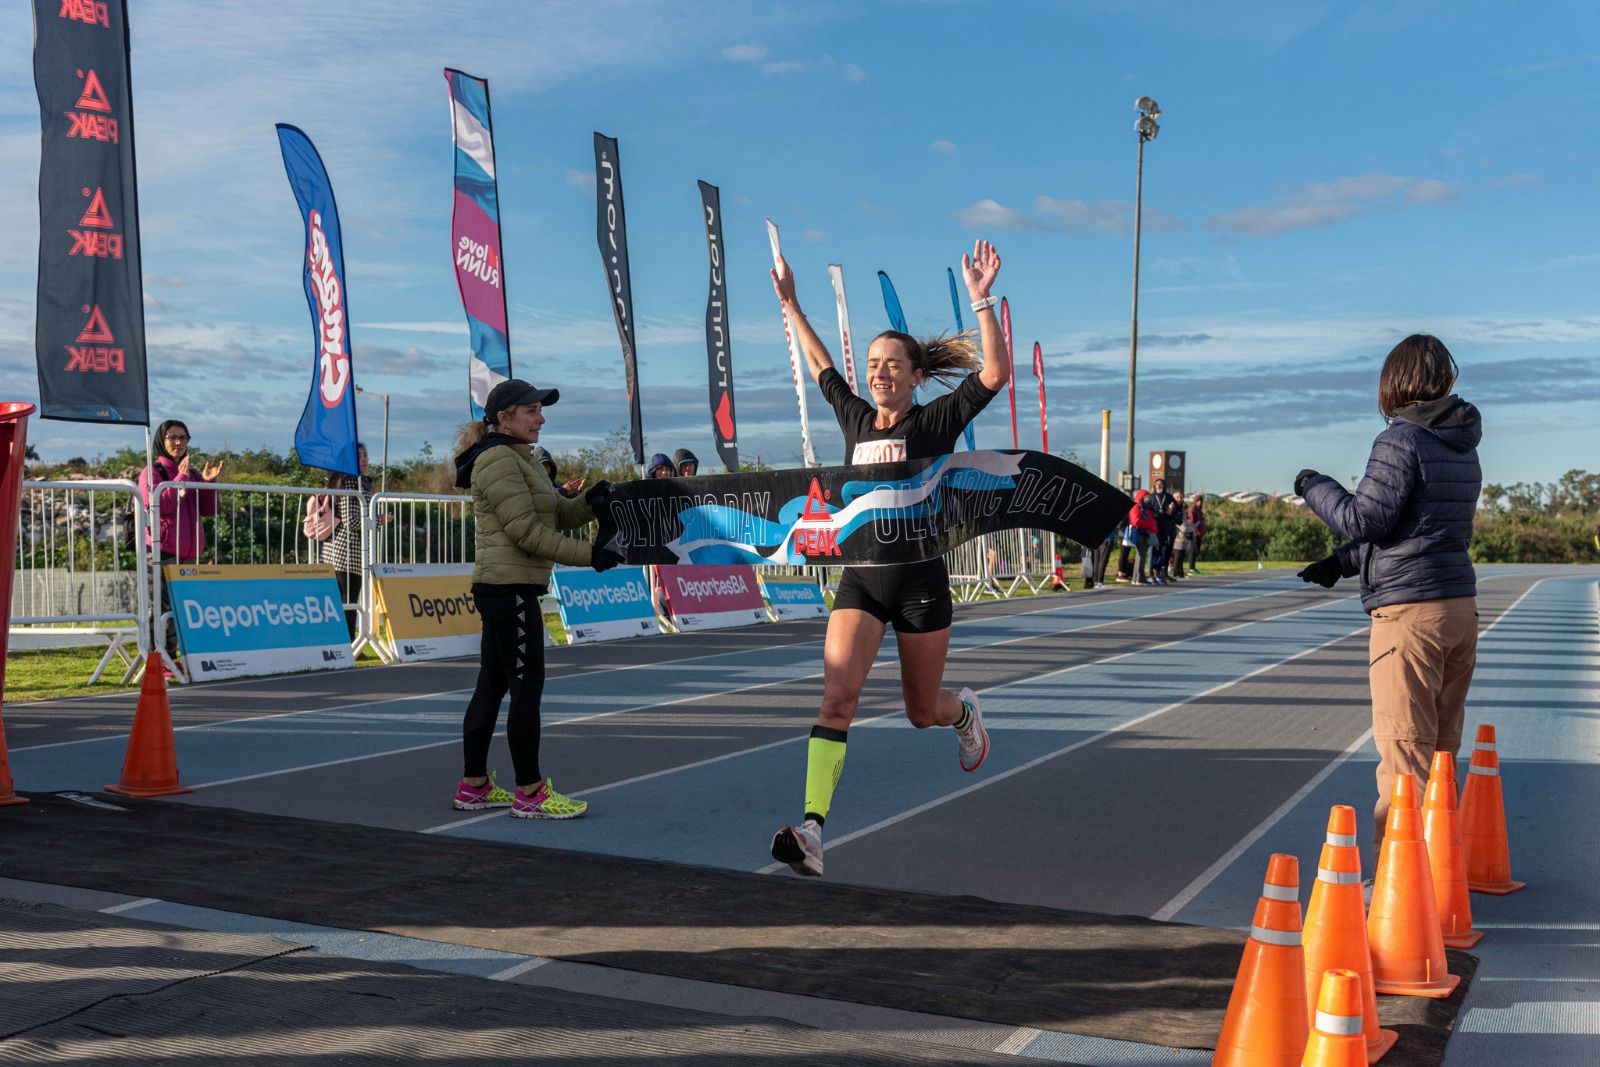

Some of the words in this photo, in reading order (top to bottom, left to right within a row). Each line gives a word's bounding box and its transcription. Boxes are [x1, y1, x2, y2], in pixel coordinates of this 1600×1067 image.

[610, 494, 720, 547] OLYMPIC
[723, 491, 770, 545] DAY
[873, 471, 1011, 544] OLYMPIC
[1007, 467, 1099, 522] DAY
[794, 527, 842, 557] PEAK
[560, 581, 648, 612] DeportesBA
[676, 574, 749, 602] DeportesBA
[183, 596, 341, 636] DeportesBA
[408, 592, 476, 624] Deport
[201, 659, 217, 672] BA
[322, 650, 337, 662] BA
